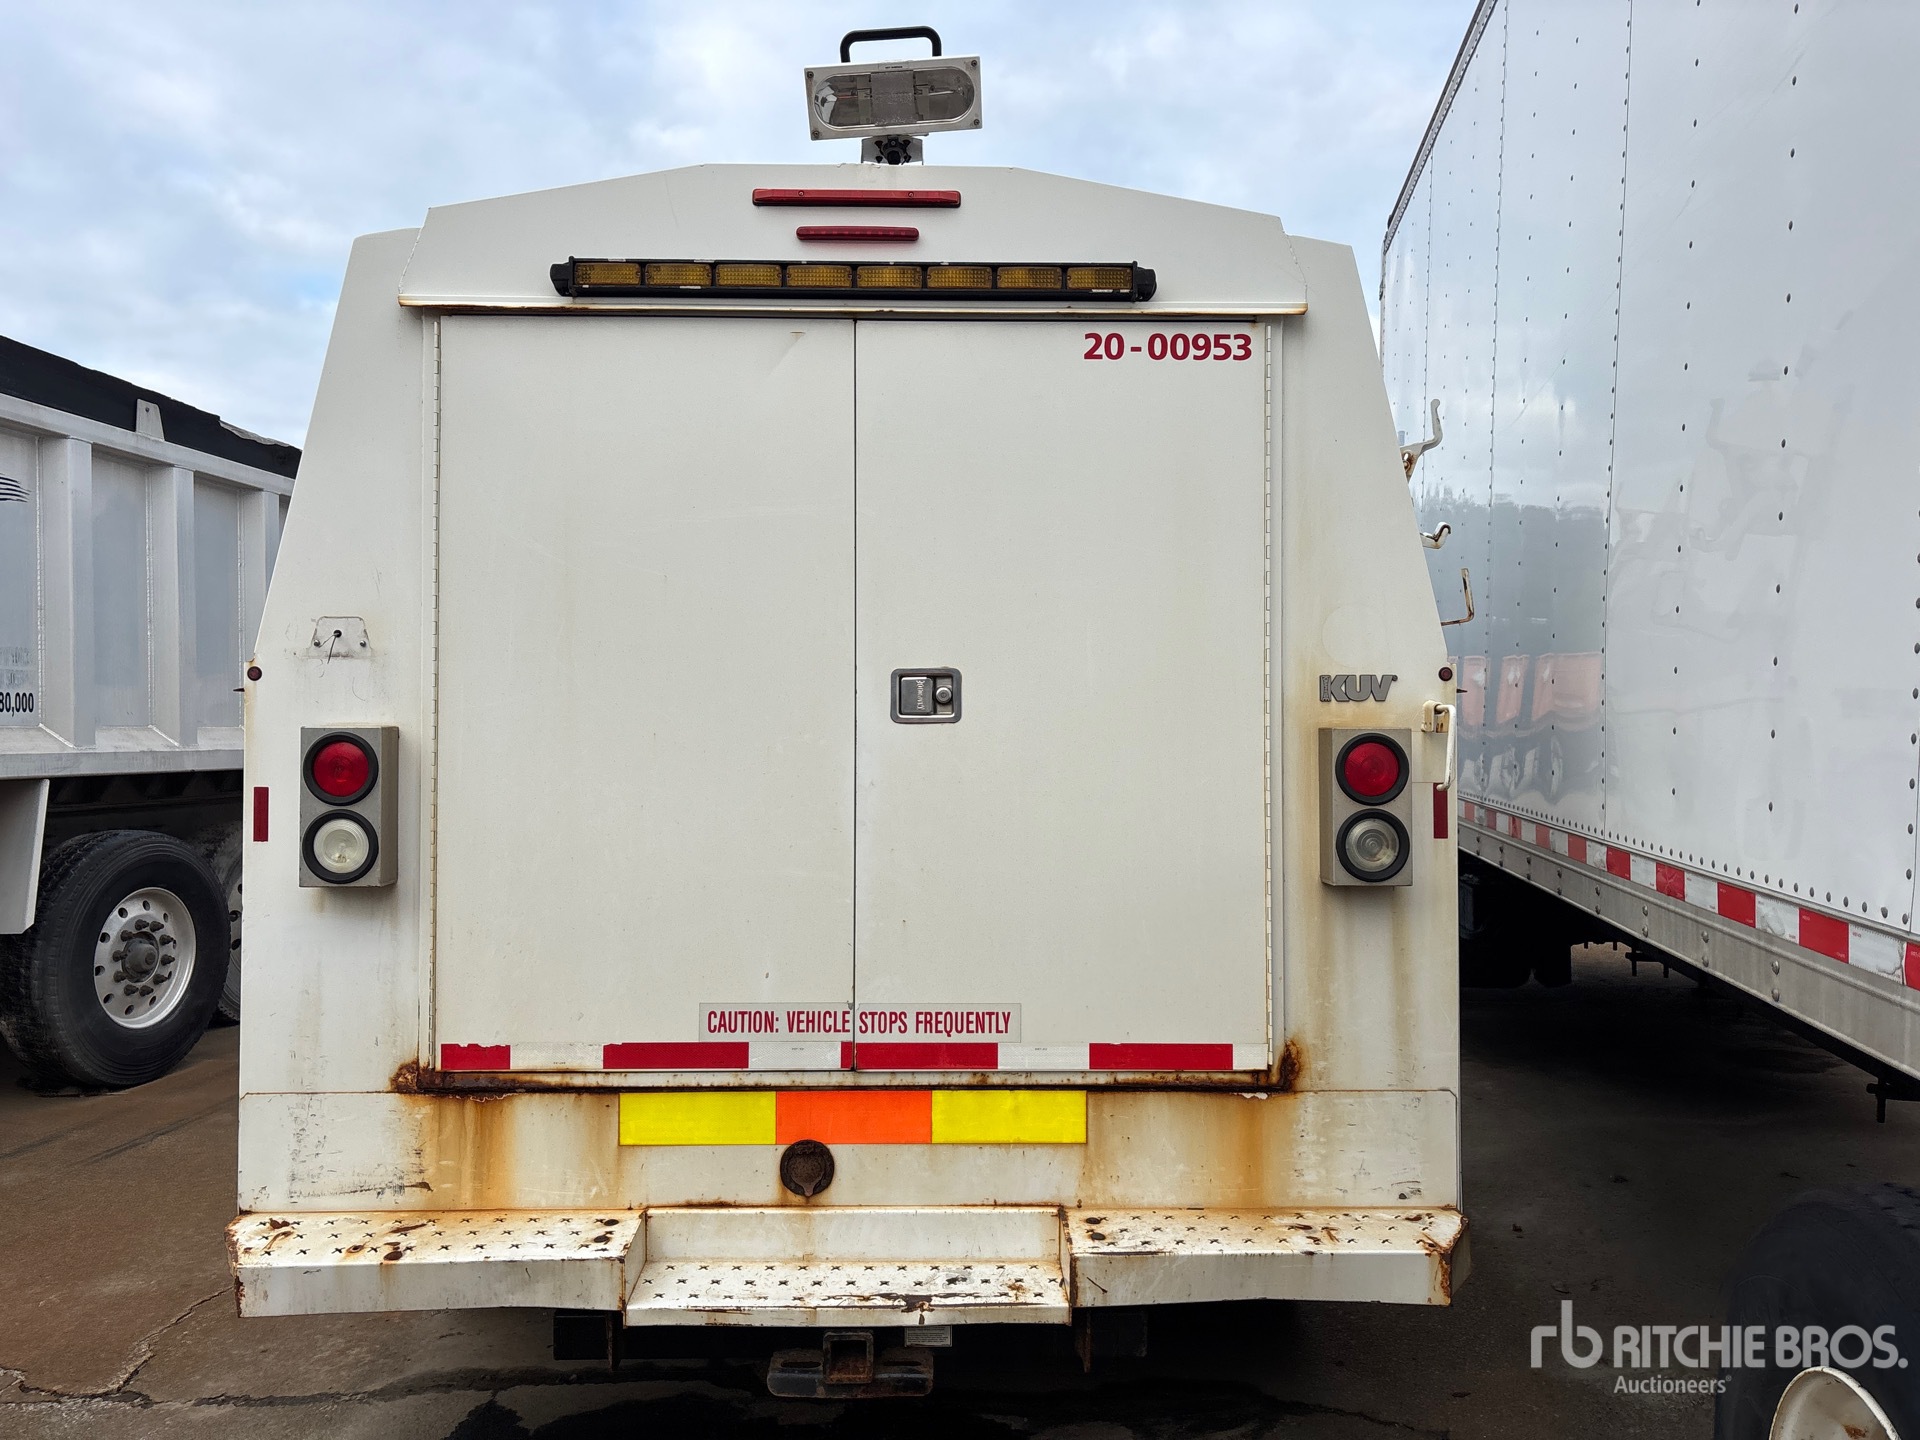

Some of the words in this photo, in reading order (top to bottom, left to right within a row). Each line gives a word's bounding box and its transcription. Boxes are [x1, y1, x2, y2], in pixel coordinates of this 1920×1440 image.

[1319, 674, 1394, 702] KUV
[707, 1010, 779, 1033] CAUTION:
[786, 1010, 850, 1033] VEHICLE
[859, 1011, 908, 1034] STOPS
[915, 1011, 1011, 1037] FREQUENTLY
